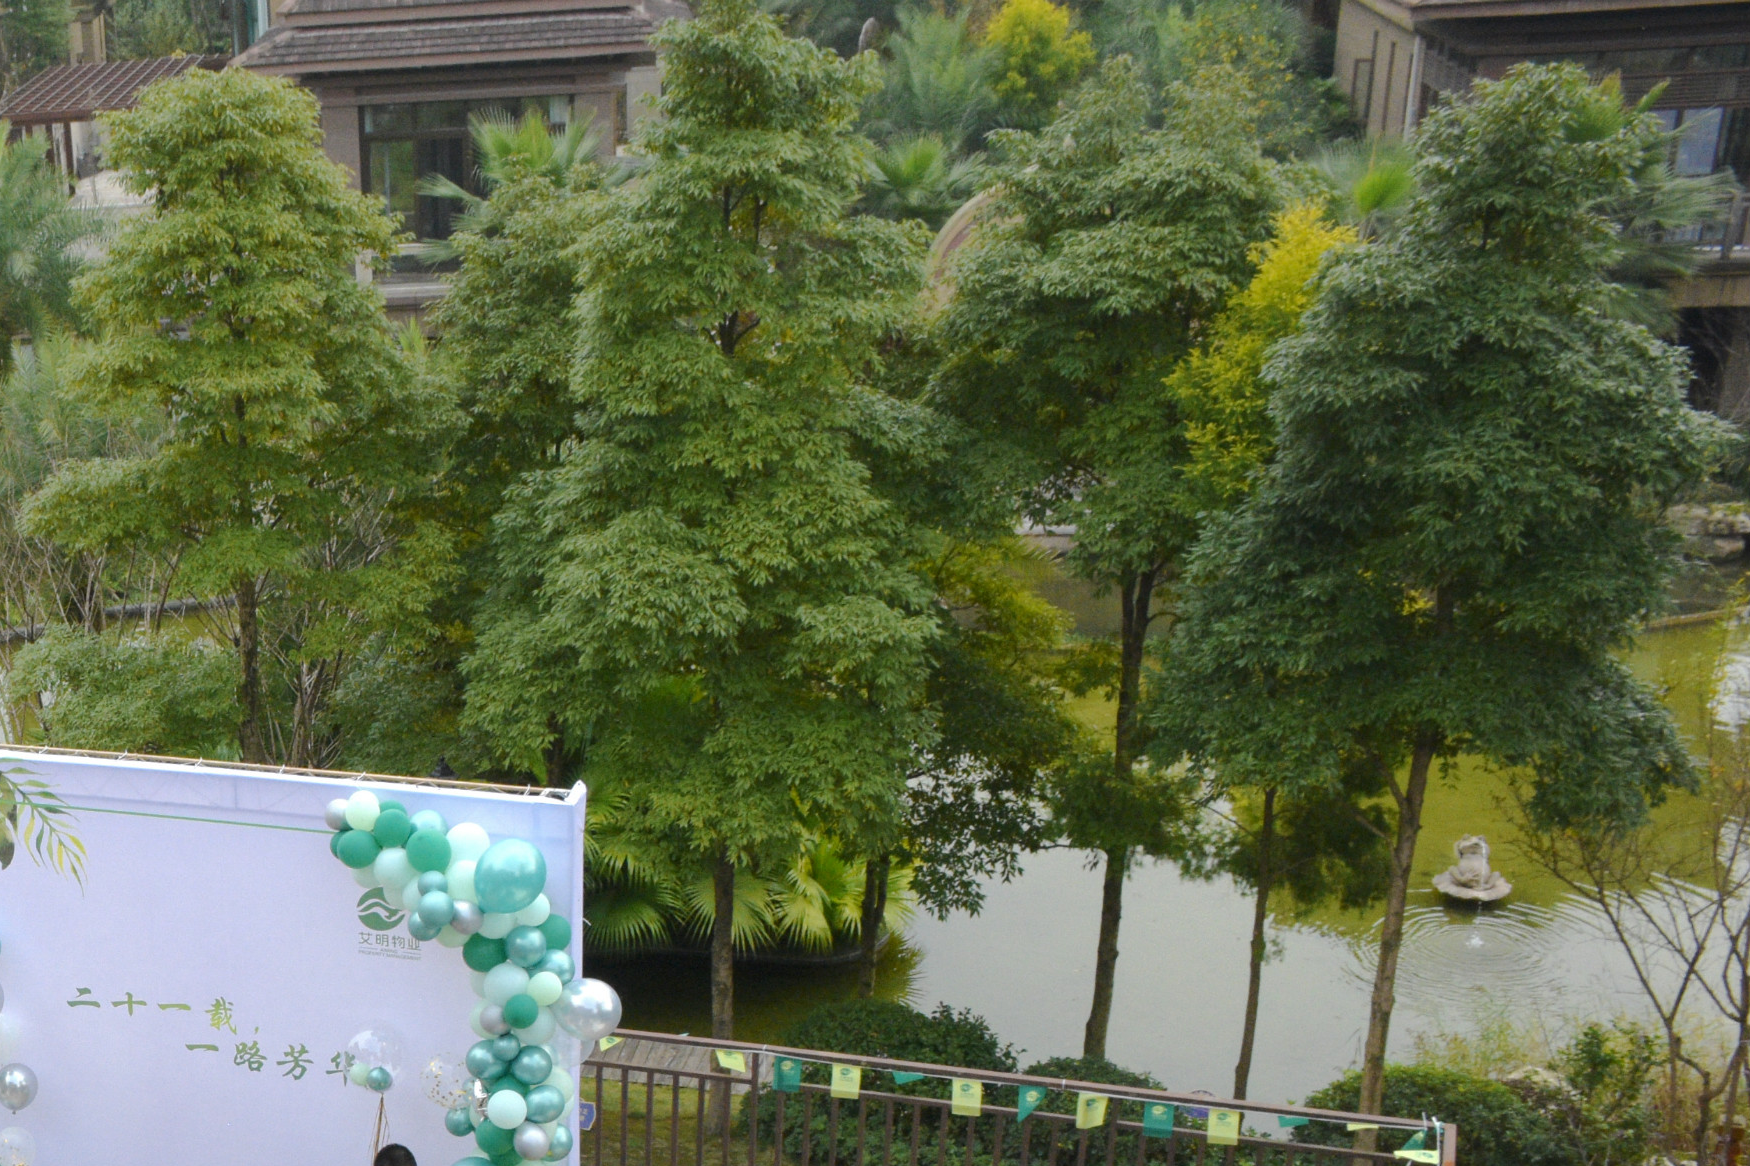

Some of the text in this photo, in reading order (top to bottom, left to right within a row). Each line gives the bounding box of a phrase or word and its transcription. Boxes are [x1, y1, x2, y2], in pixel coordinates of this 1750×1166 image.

[358, 932, 421, 950] 艾明物业
[185, 1040, 357, 1087] 一路芳华
